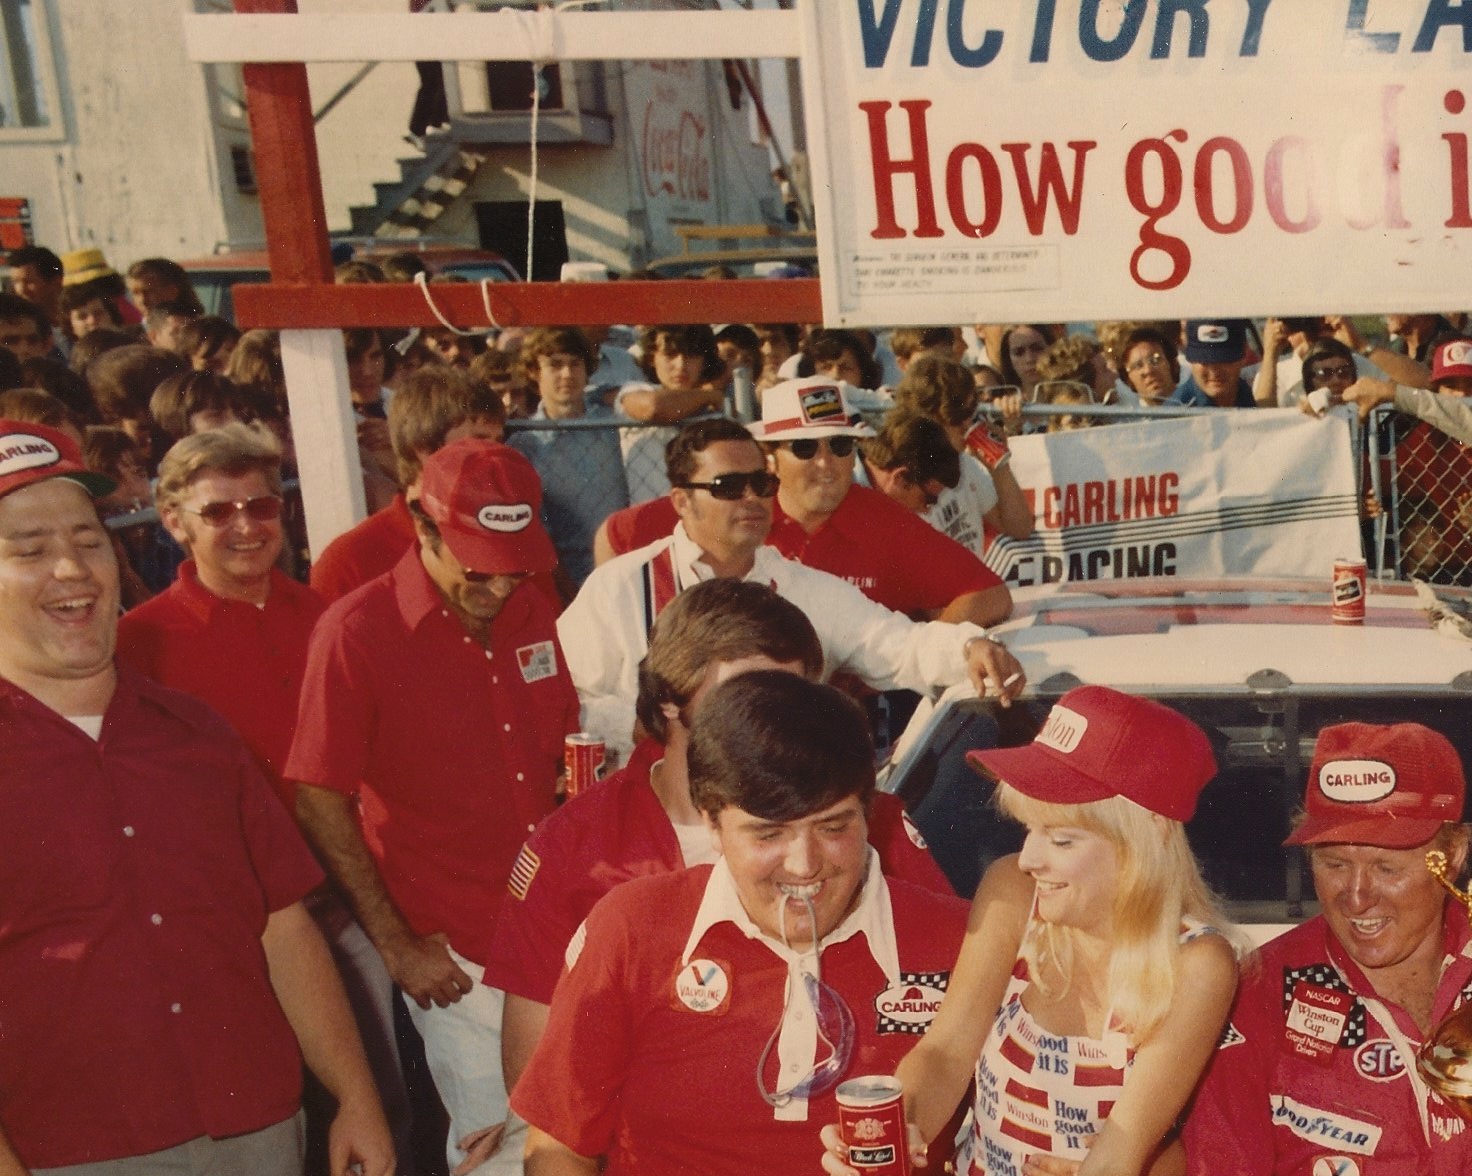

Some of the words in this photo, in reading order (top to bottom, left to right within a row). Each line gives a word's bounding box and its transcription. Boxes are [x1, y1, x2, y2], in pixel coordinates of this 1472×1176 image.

[857, 0, 1272, 68] VICTORY
[858, 100, 1097, 239] How
[1126, 84, 1412, 290] good
[0, 444, 52, 462] ARLING
[1043, 471, 1180, 530] CARLING
[1042, 542, 1177, 585] RACING
[1326, 771, 1391, 787] CARLING
[1305, 990, 1341, 1006] NASCAR
[1298, 1003, 1340, 1027] Winston
[1303, 1018, 1325, 1037] Cup
[1039, 1035, 1070, 1054] ood
[1054, 1055, 1070, 1076] is
[1362, 1043, 1403, 1075] STP
[1007, 1101, 1050, 1128] Winston
[1054, 1099, 1088, 1122] How
[1054, 1120, 1096, 1135] good
[1066, 1135, 1081, 1149] it
